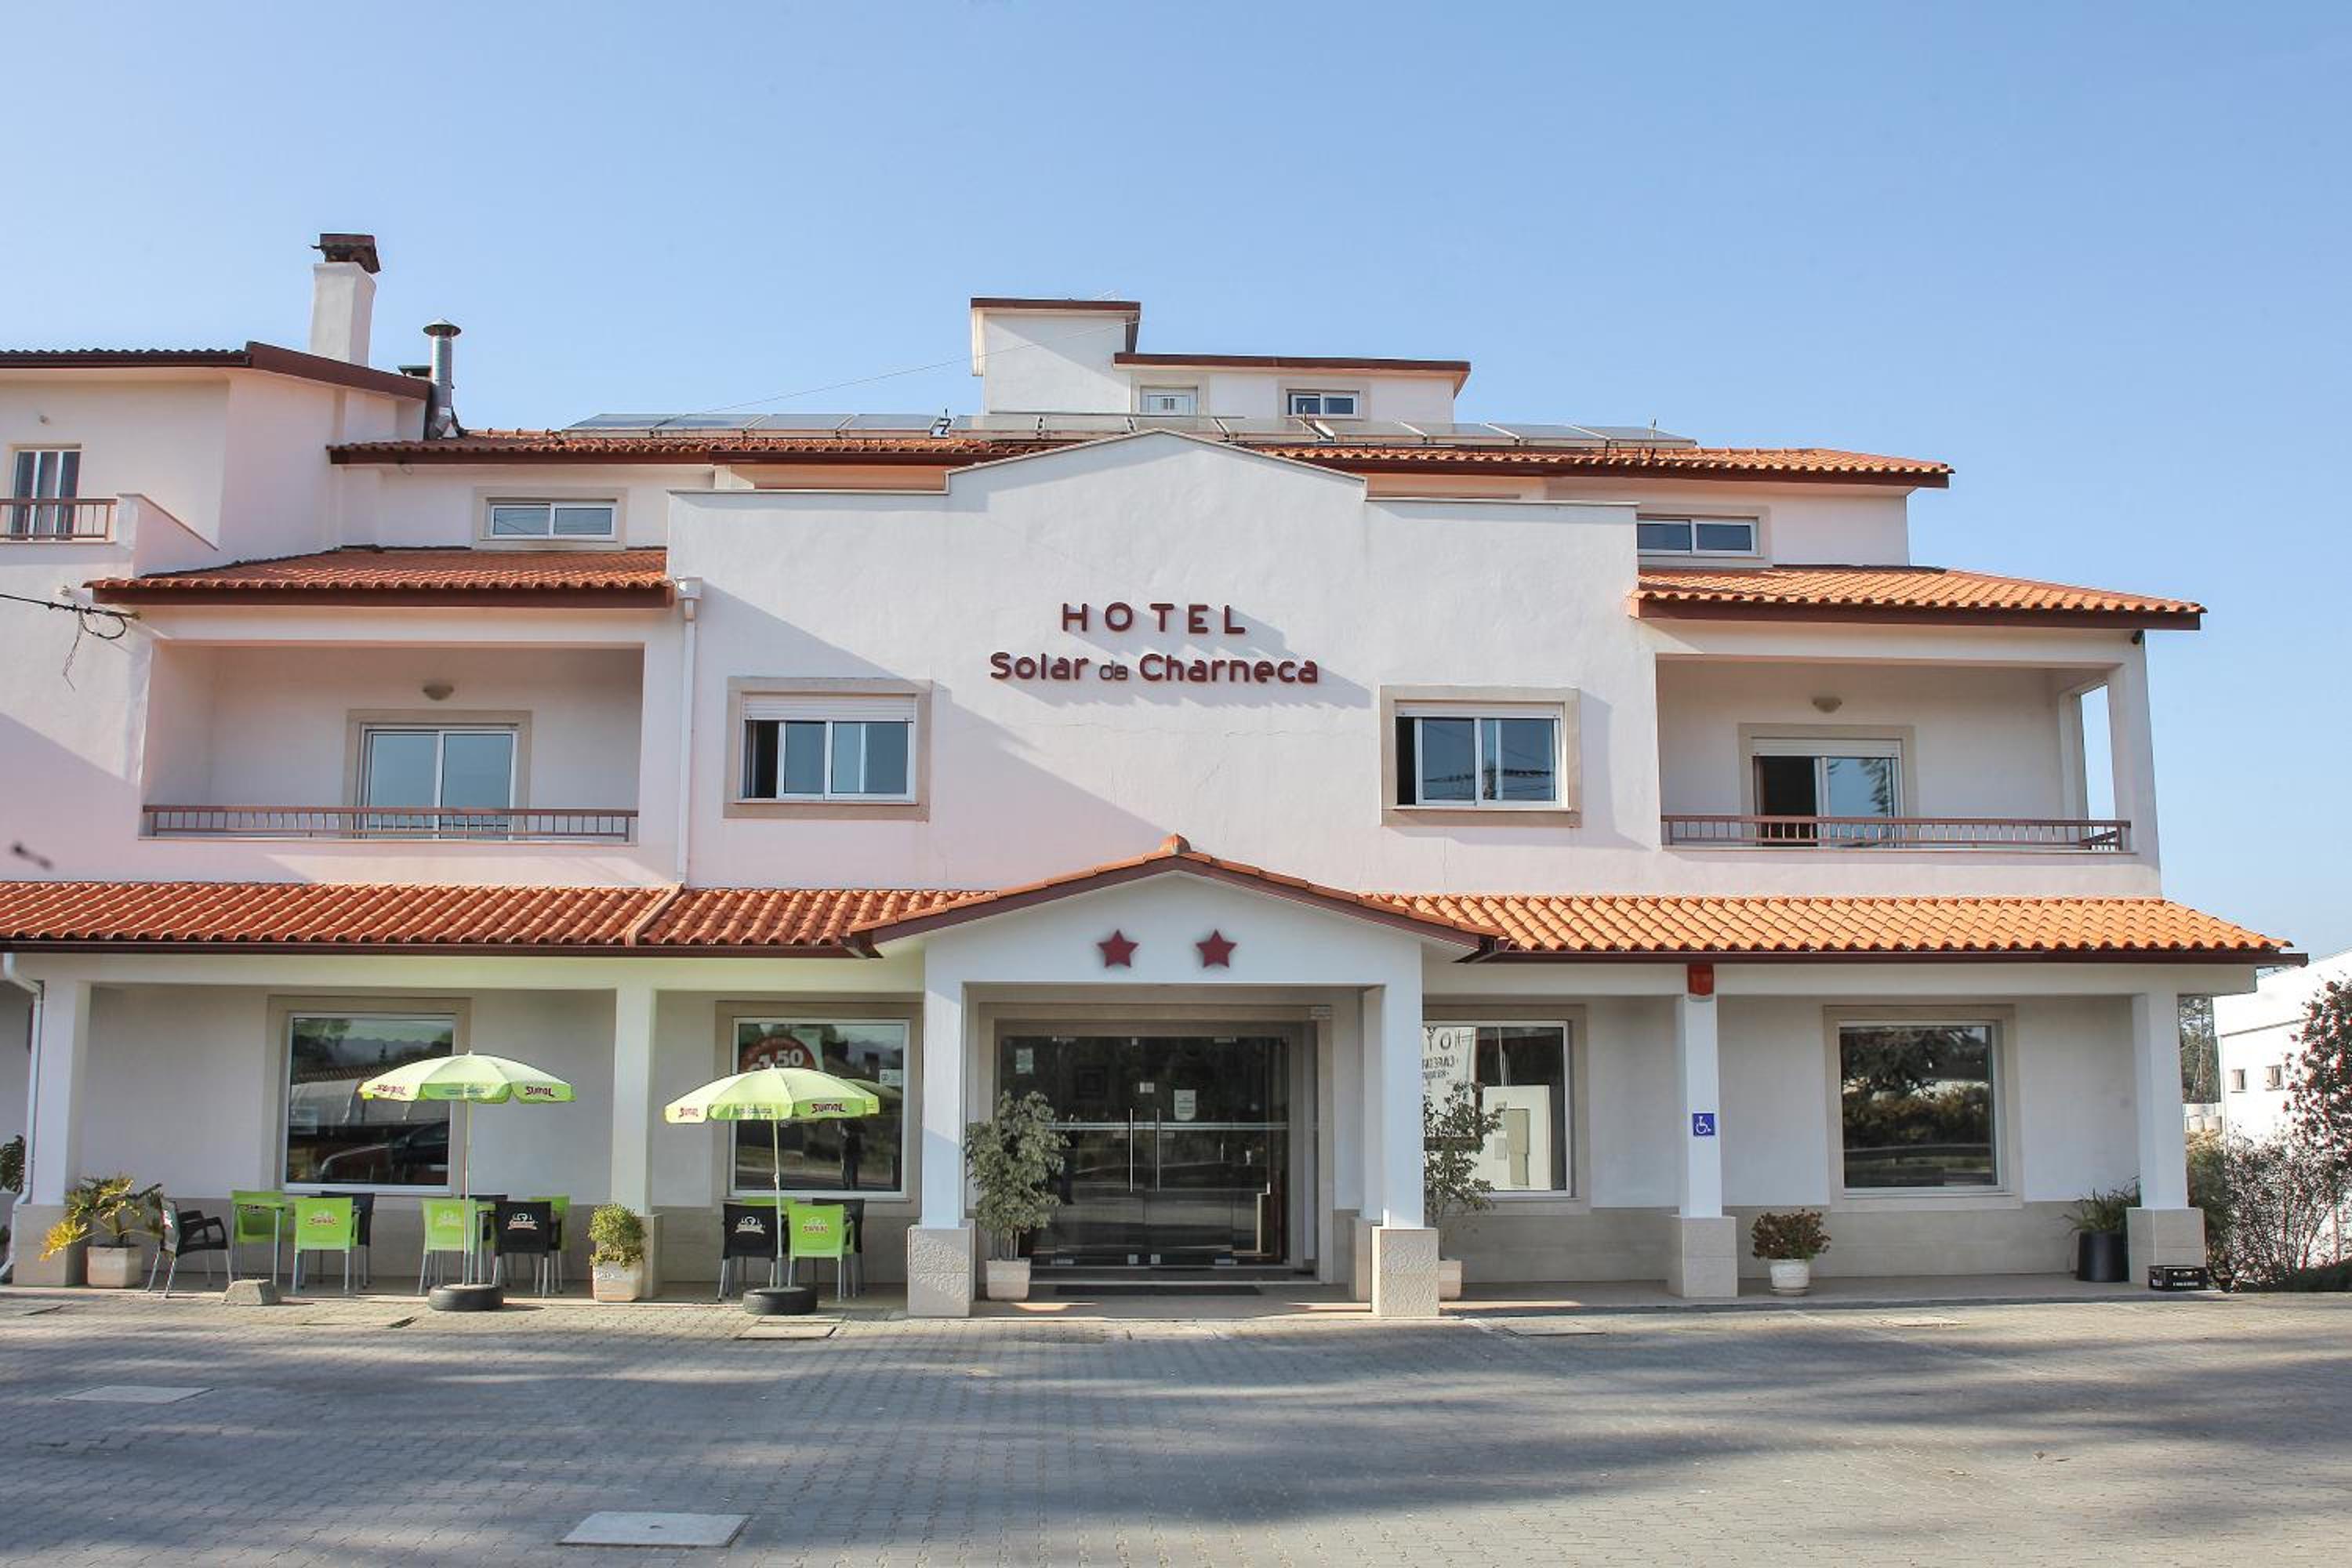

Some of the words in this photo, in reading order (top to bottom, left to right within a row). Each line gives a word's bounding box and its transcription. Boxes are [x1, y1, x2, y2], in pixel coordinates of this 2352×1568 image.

[1062, 601, 1246, 634] HOTEL
[990, 652, 1089, 681] Solar
[1139, 653, 1319, 684] Charneca
